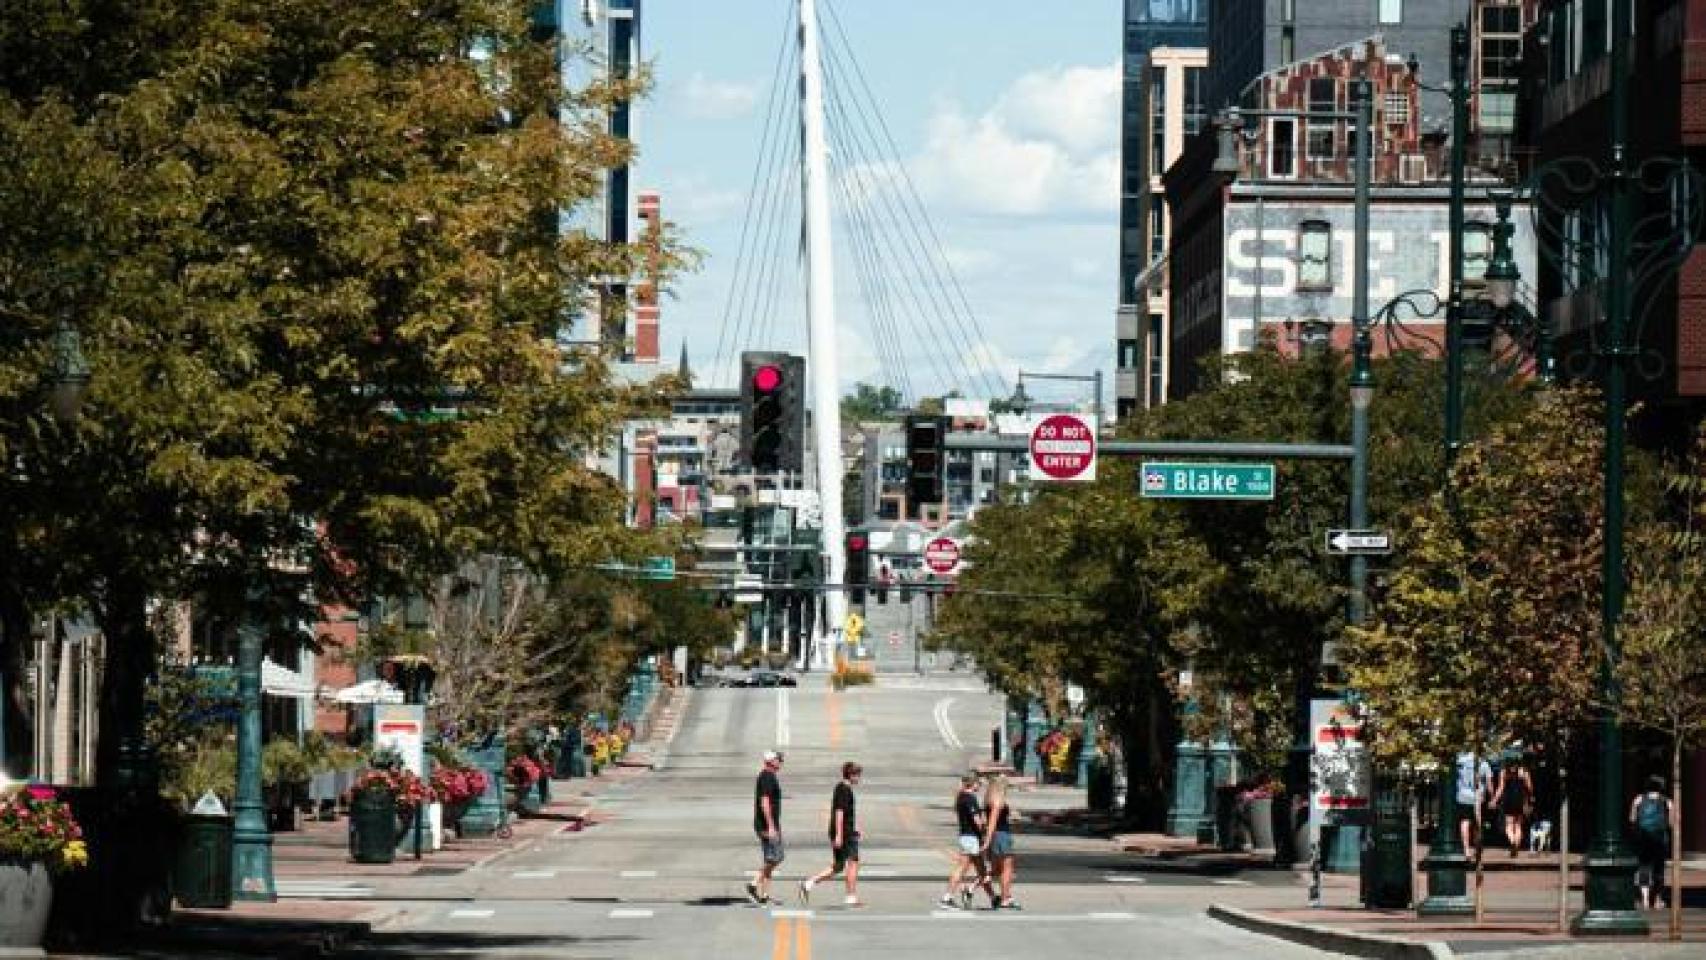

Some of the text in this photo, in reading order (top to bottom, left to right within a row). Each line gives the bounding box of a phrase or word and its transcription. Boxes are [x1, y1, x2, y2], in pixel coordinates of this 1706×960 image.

[1228, 229, 1450, 298] SE
[1041, 425, 1086, 438] DO NOT
[1043, 455, 1081, 468] ENTER
[1174, 469, 1238, 492] Blake
